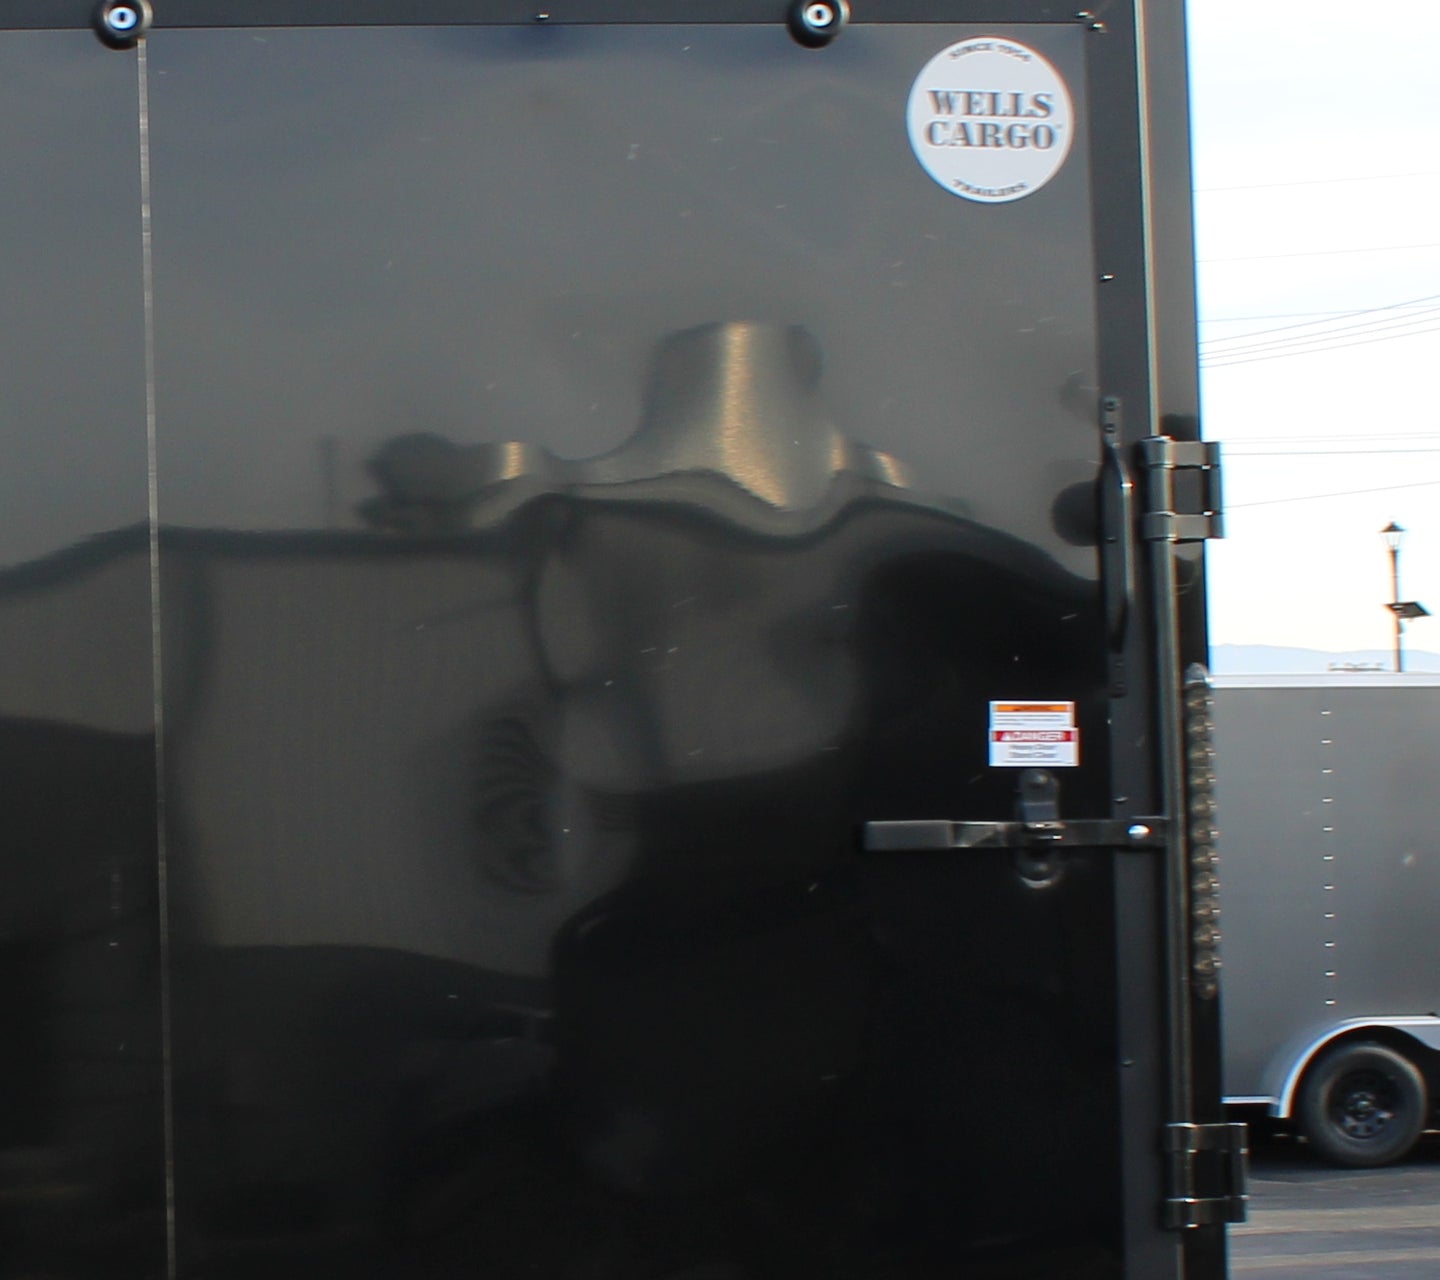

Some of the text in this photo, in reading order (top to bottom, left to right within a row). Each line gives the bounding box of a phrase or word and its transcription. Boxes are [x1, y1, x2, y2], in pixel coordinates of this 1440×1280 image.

[927, 90, 1053, 119] WELLS
[925, 120, 1054, 150] CARGO
[952, 178, 1028, 197] TRAILERS
[1011, 730, 1063, 742] DANGER
